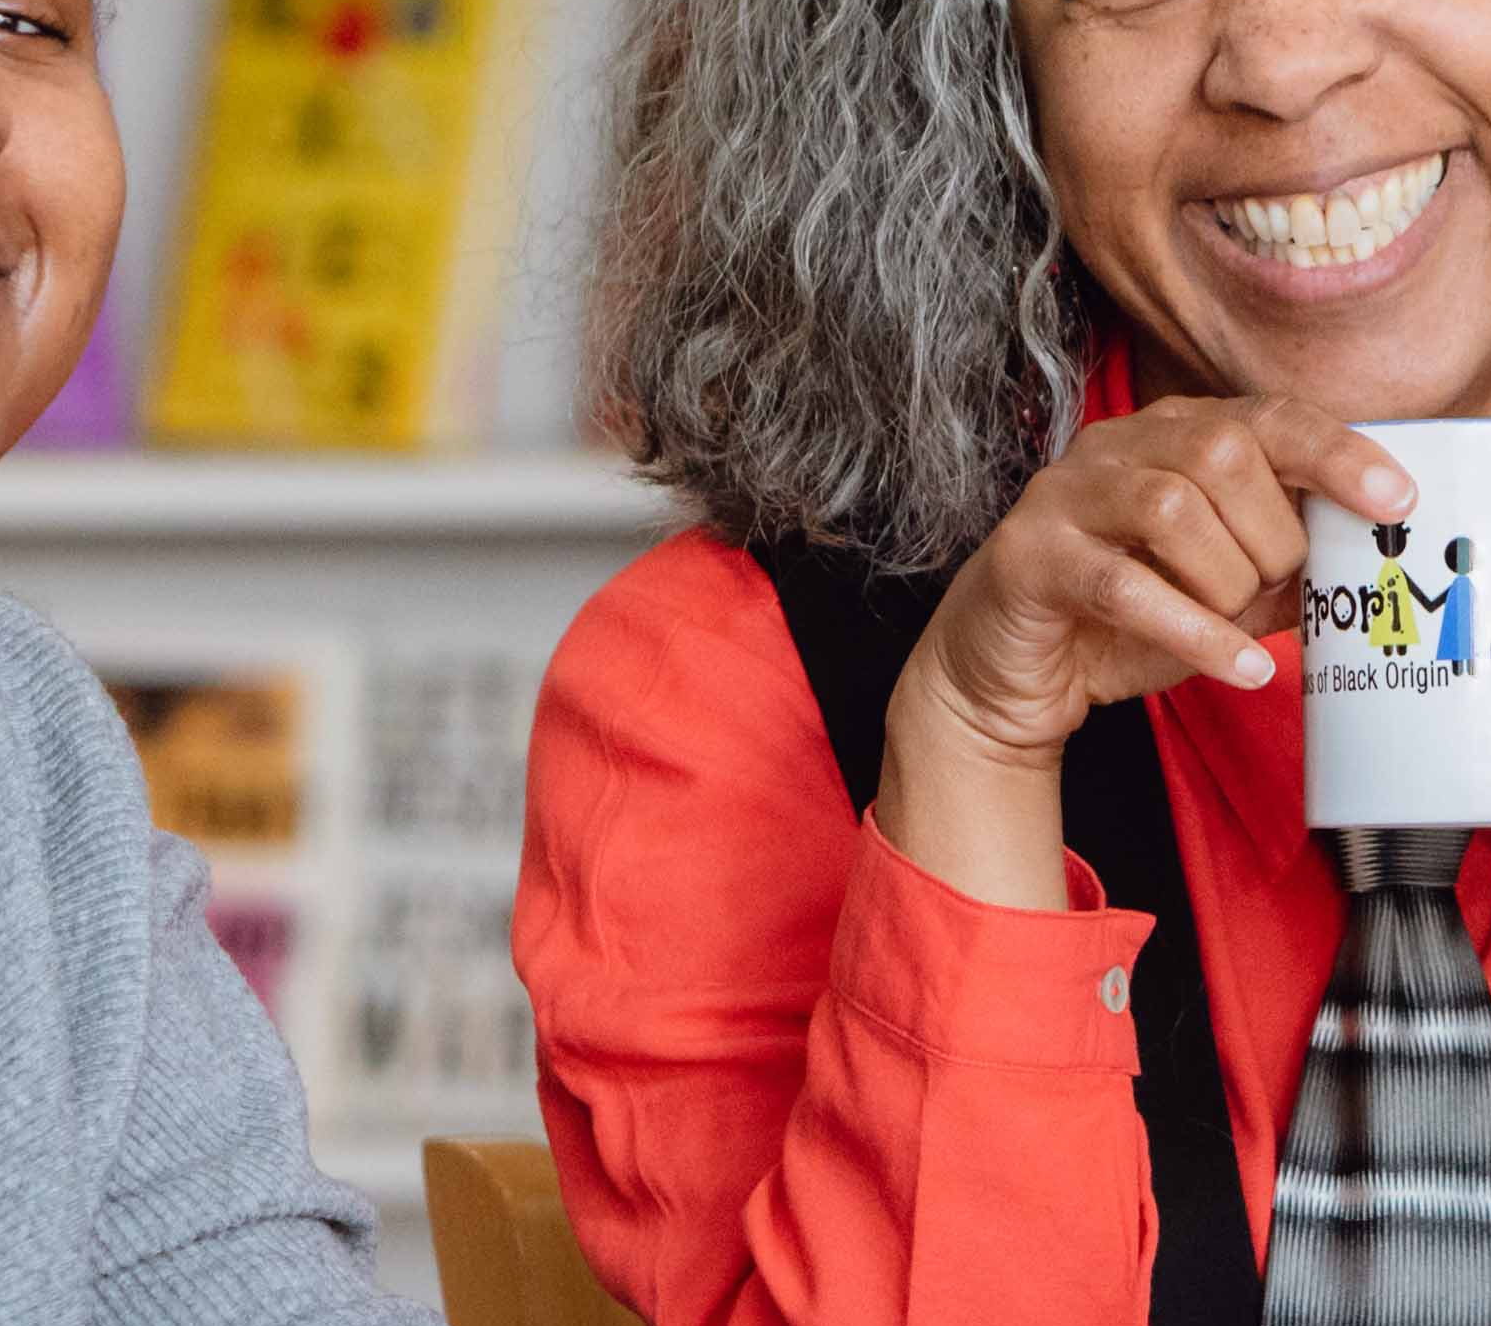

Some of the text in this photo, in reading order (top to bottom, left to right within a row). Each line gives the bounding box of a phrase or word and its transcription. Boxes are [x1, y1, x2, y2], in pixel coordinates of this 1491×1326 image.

[1317, 666, 1328, 694] of
[1333, 663, 1379, 692] Black
[1386, 661, 1450, 695] Origin
